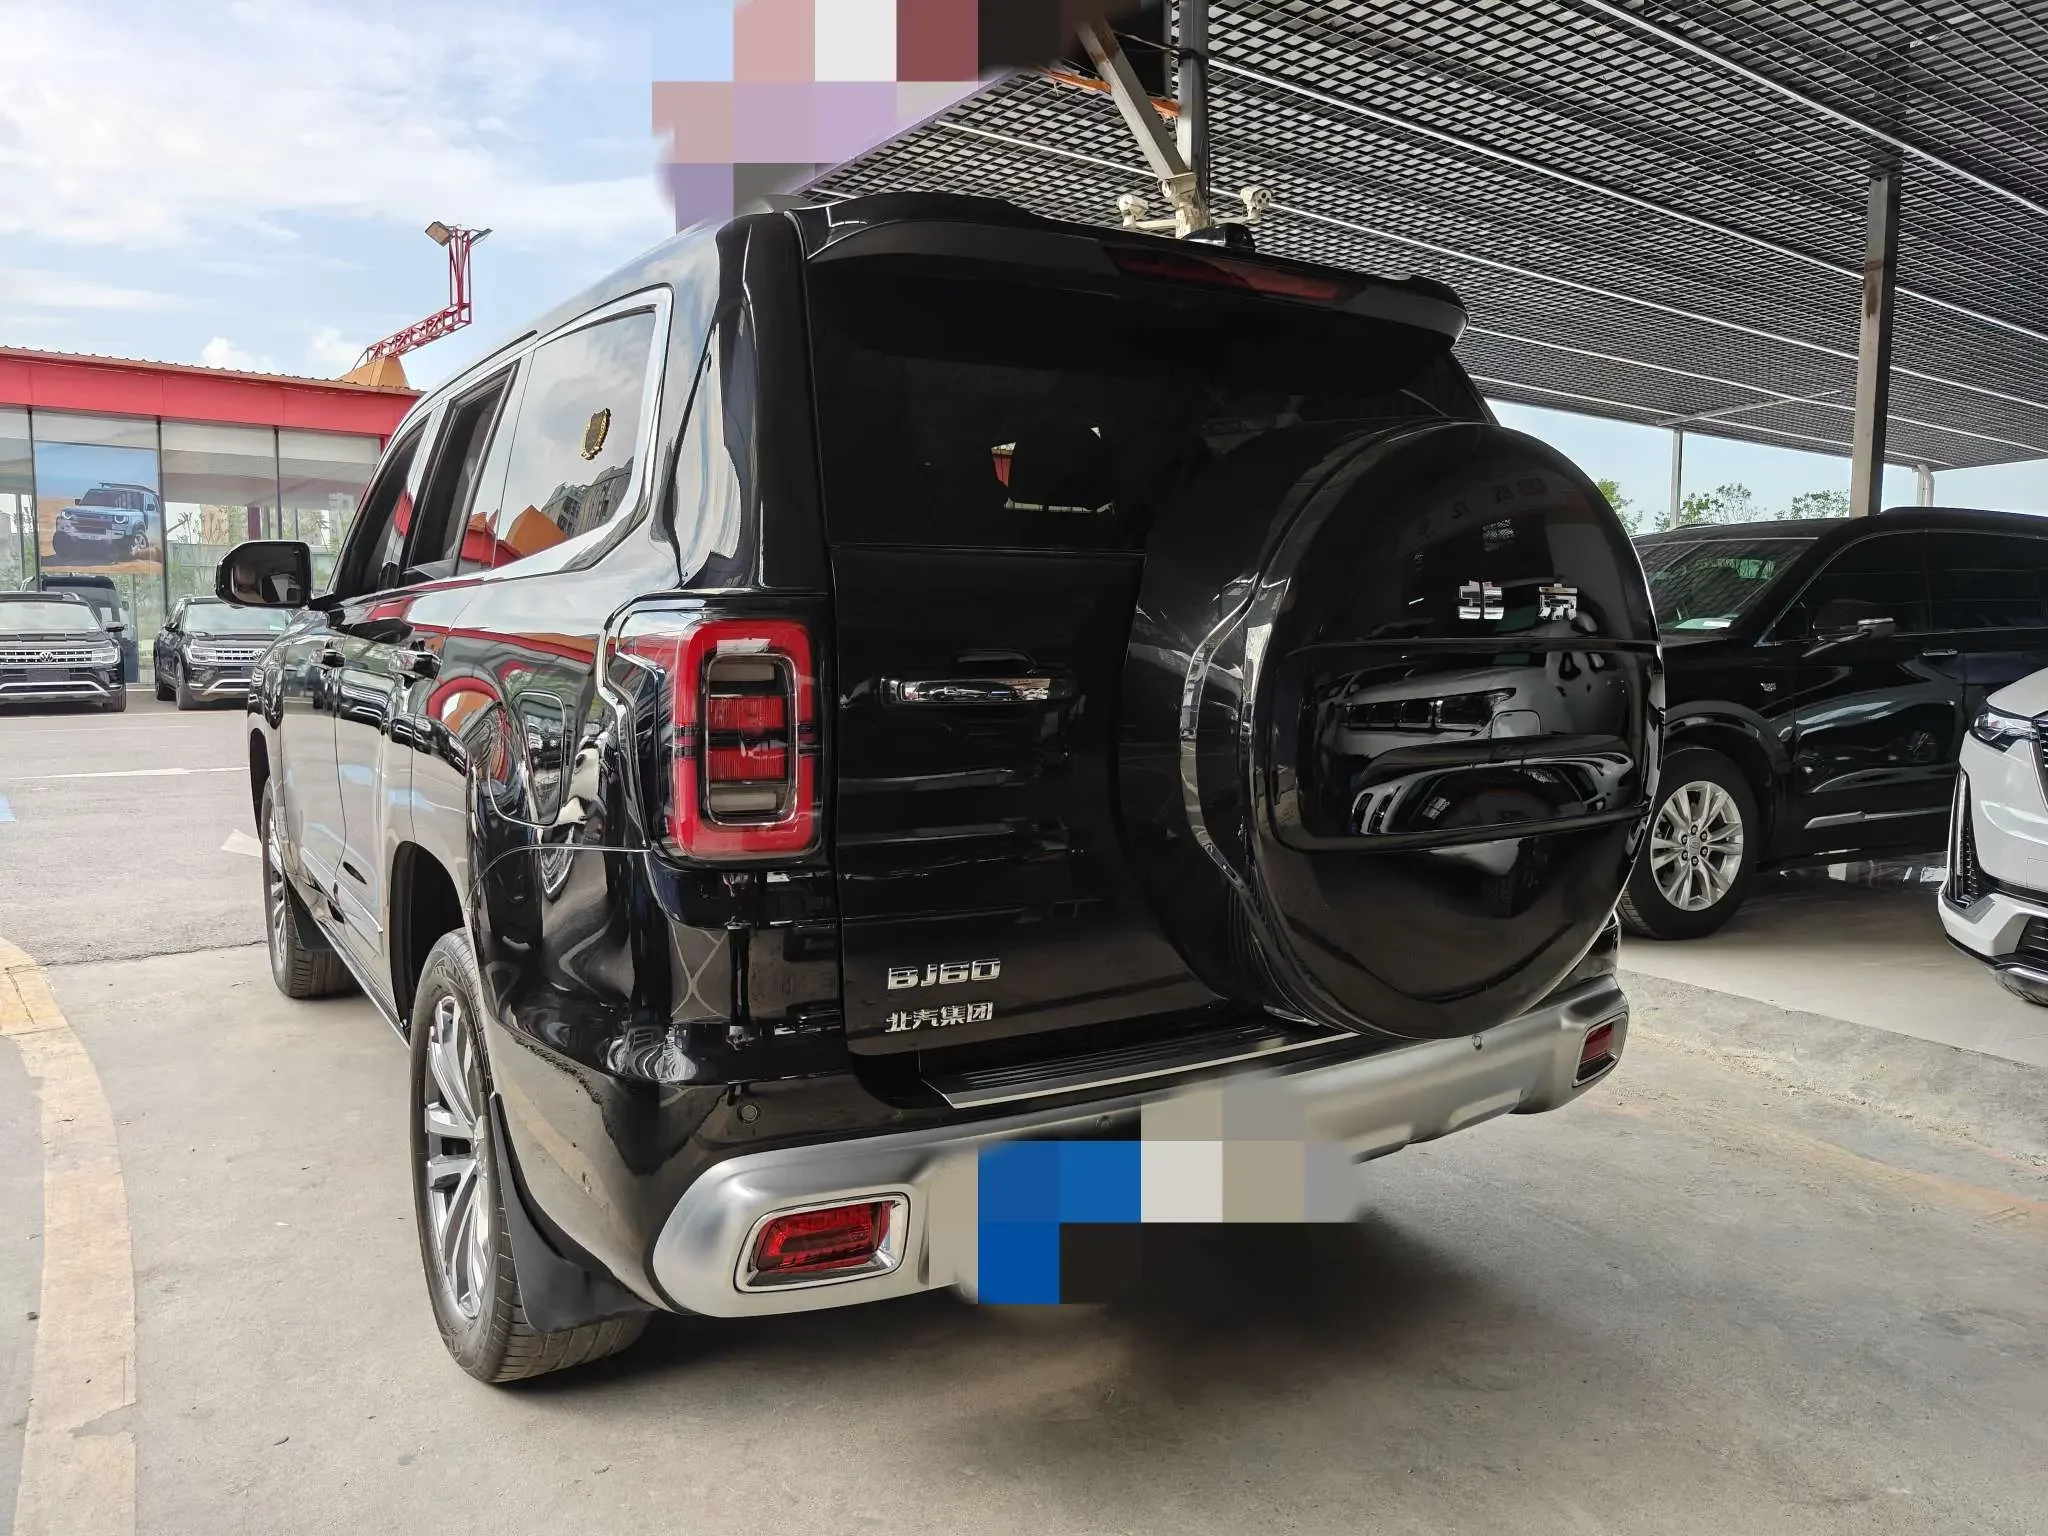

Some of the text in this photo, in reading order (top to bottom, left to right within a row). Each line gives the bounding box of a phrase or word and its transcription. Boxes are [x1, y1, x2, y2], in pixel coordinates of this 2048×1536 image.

[1458, 580, 1578, 620] 北京
[887, 958, 1001, 990] BJ60
[885, 1002, 994, 1033] 北汽集团
